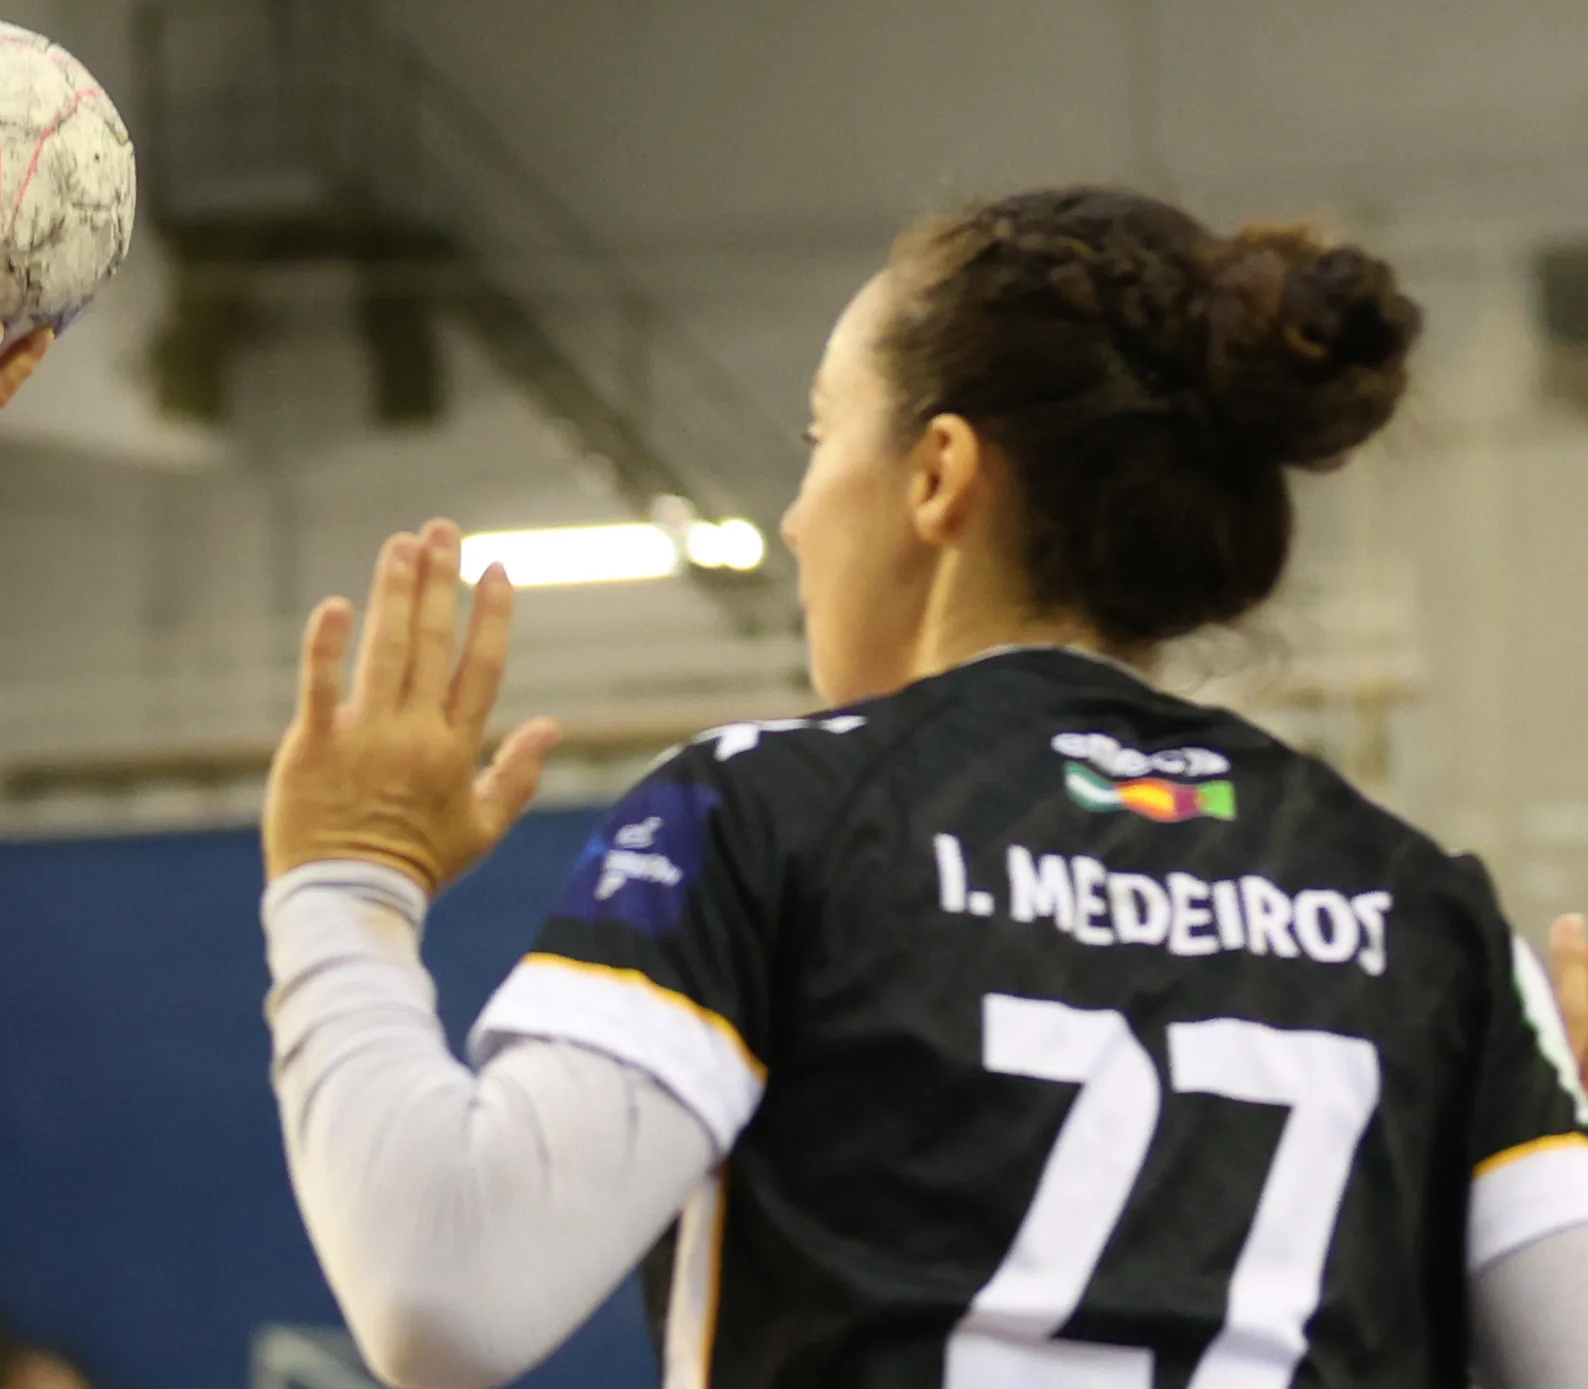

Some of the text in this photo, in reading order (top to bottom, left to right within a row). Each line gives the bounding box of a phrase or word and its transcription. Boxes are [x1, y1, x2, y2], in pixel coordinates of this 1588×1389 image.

[934, 832, 1393, 977] I. MEDEIROS
[942, 992, 1381, 1389] 27
